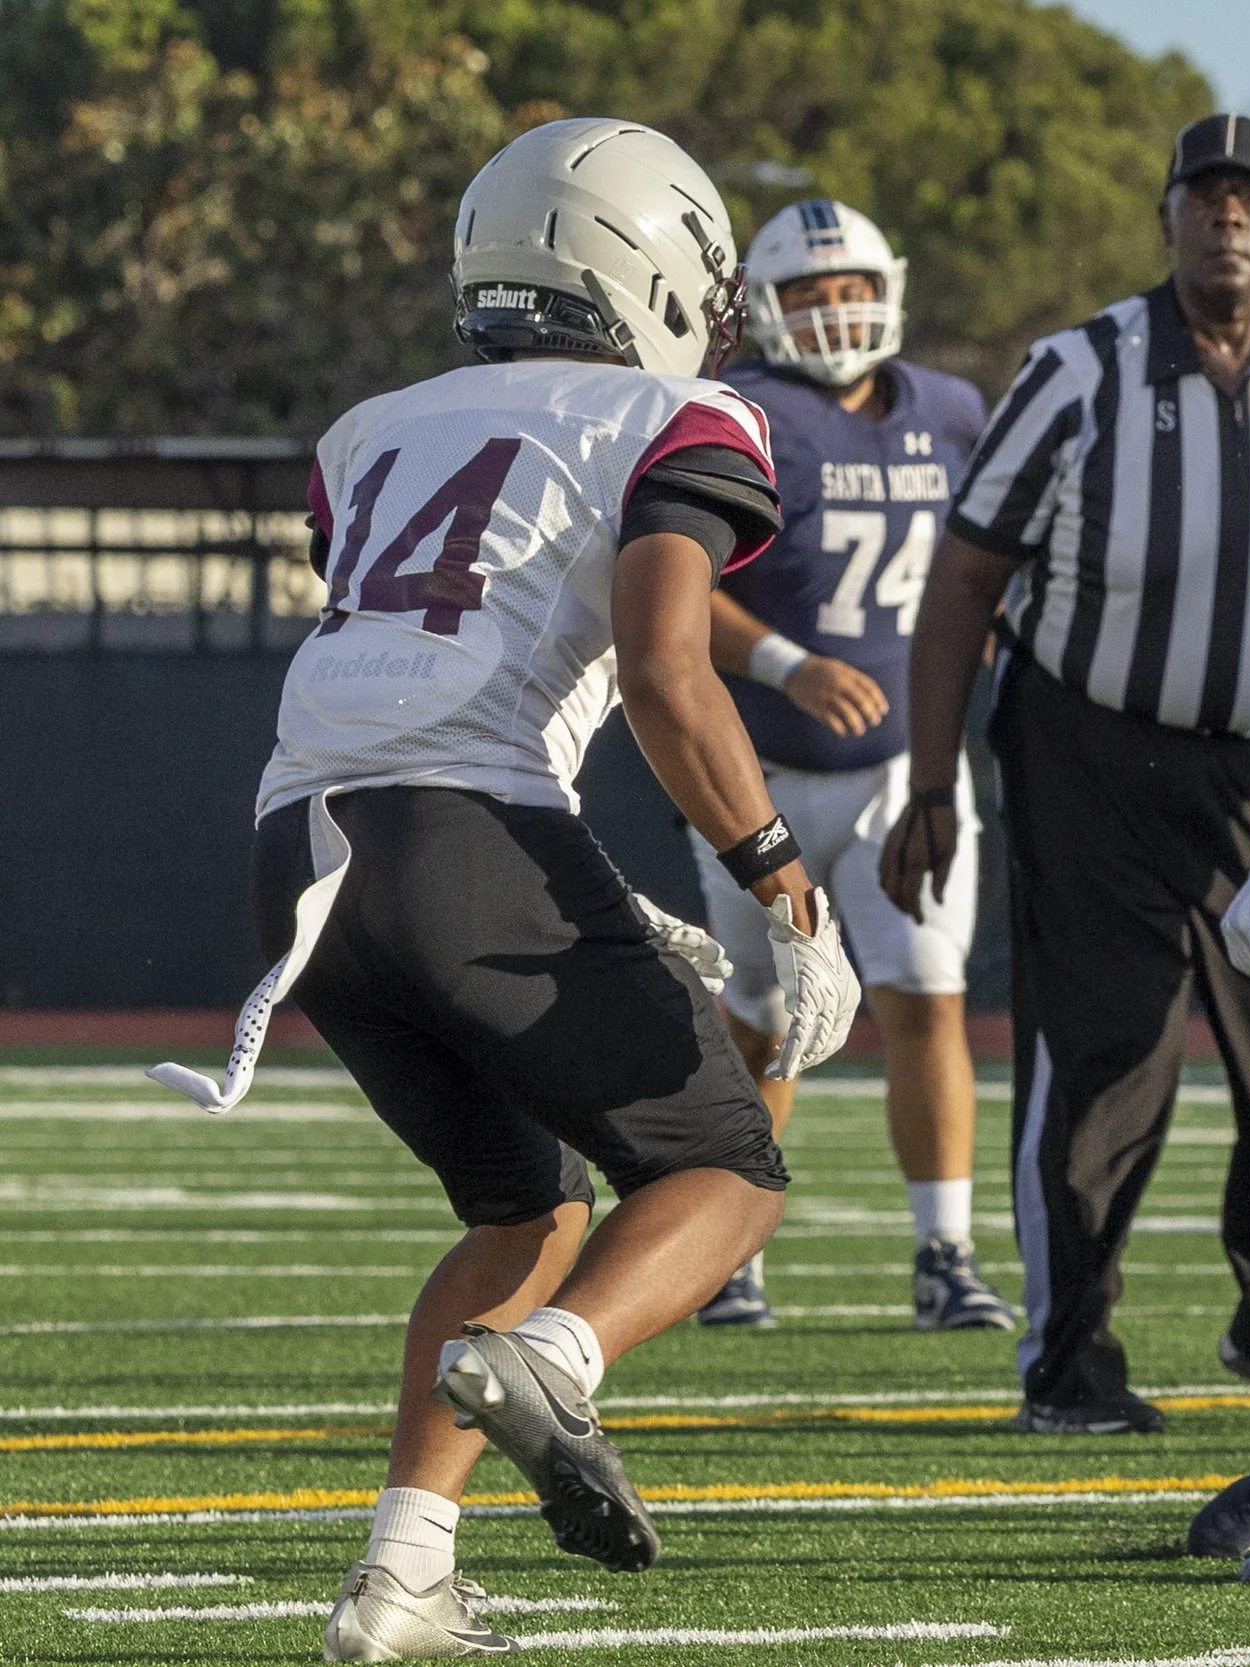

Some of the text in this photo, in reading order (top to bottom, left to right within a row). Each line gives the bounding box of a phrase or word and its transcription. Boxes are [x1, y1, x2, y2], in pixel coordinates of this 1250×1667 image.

[477, 284, 537, 310] schutt
[1155, 400, 1177, 432] S
[821, 461, 949, 502] SANTA MONICA
[315, 437, 522, 639] 14
[816, 510, 936, 638] 74
[311, 651, 437, 681] Riddell
